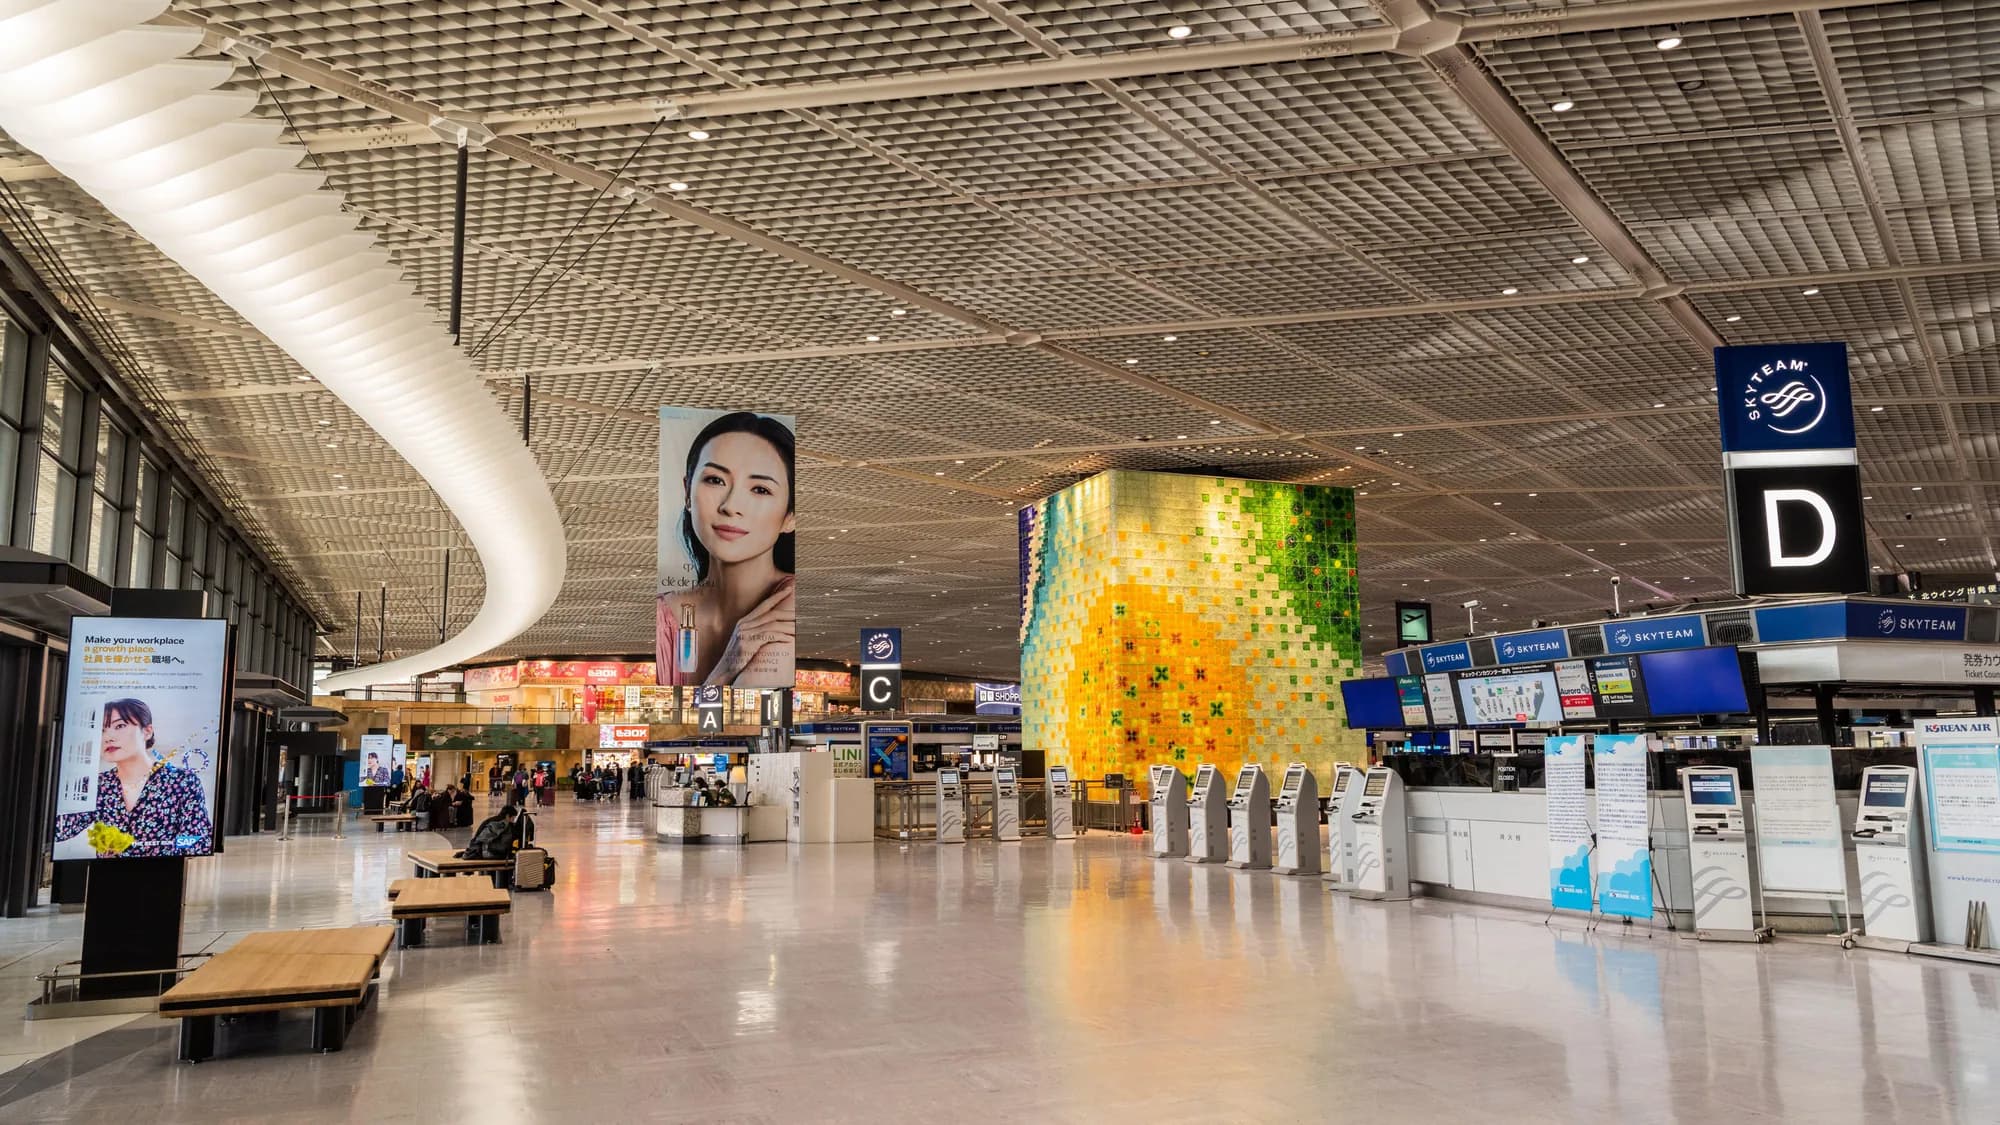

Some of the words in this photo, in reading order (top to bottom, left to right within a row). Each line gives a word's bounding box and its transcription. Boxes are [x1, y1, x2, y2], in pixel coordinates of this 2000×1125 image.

[1744, 359, 1804, 421] SKYTEAM
[1763, 488, 1837, 568] D
[1900, 618, 1956, 631] SKYTEAM
[85, 635, 111, 644] Make
[113, 637, 135, 646] your
[136, 636, 185, 646] workplace
[1634, 628, 1694, 642] SKYTEAM
[92, 645, 126, 654] growth
[1517, 641, 1560, 654] SKYTEAM
[1436, 653, 1465, 664] SKYTEAM
[1964, 669, 1983, 679] Ticket
[869, 676, 892, 703] C
[1559, 687, 1582, 695] Aurora
[703, 711, 717, 729] A
[1924, 723, 1968, 733] KOREAN
[1969, 723, 1992, 733] AIR
[176, 838, 196, 847] SAP
